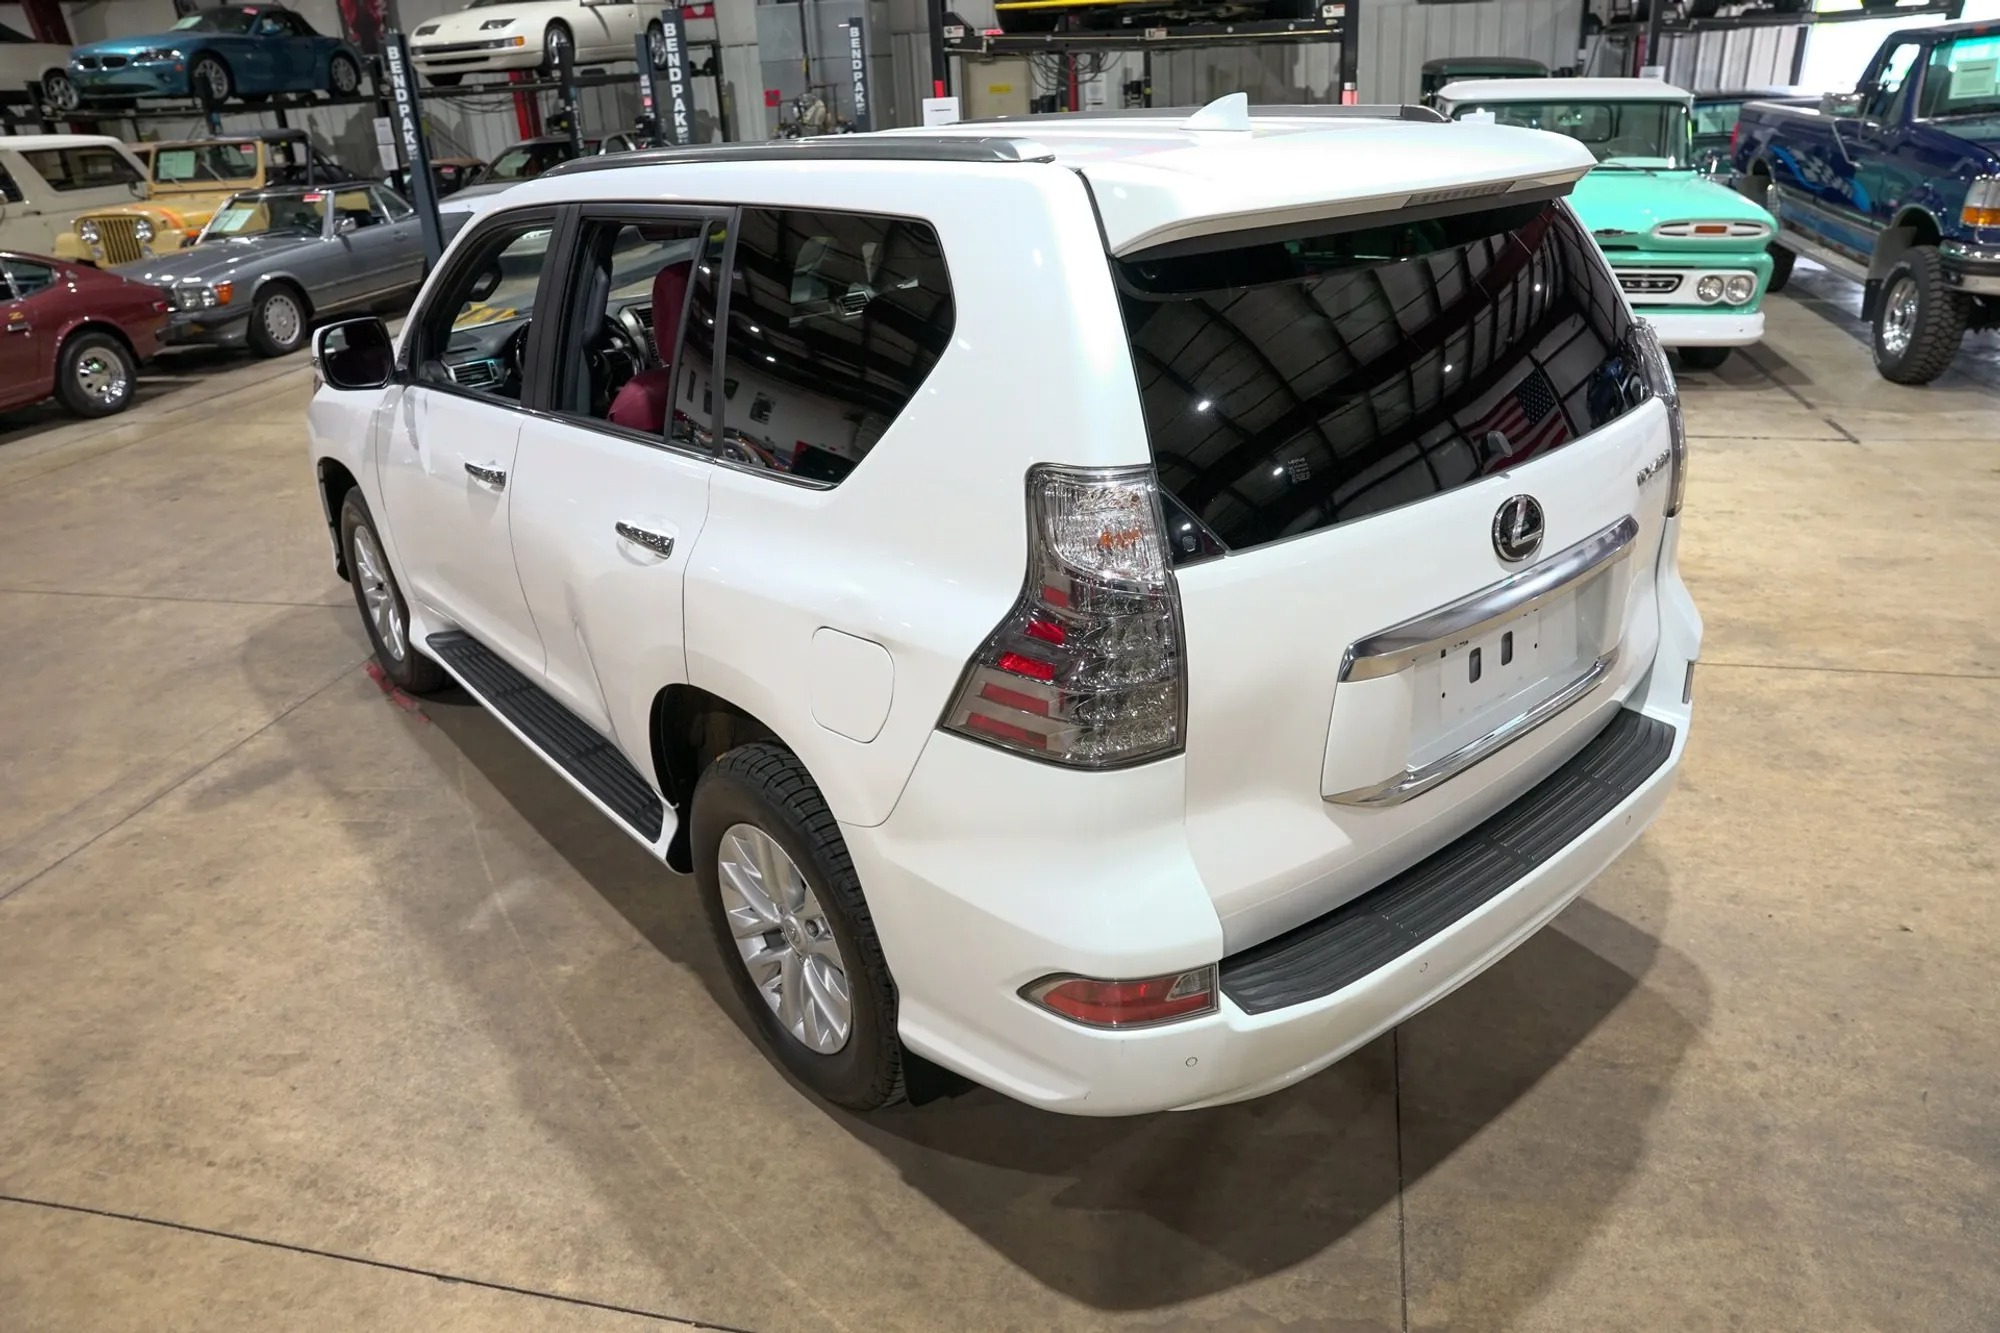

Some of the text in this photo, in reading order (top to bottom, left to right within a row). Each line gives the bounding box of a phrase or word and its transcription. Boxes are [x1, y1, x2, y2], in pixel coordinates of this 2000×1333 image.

[387, 46, 416, 144] BENDPAK
[663, 23, 688, 127] BENDPAK
[850, 27, 865, 103] BENDPAK
